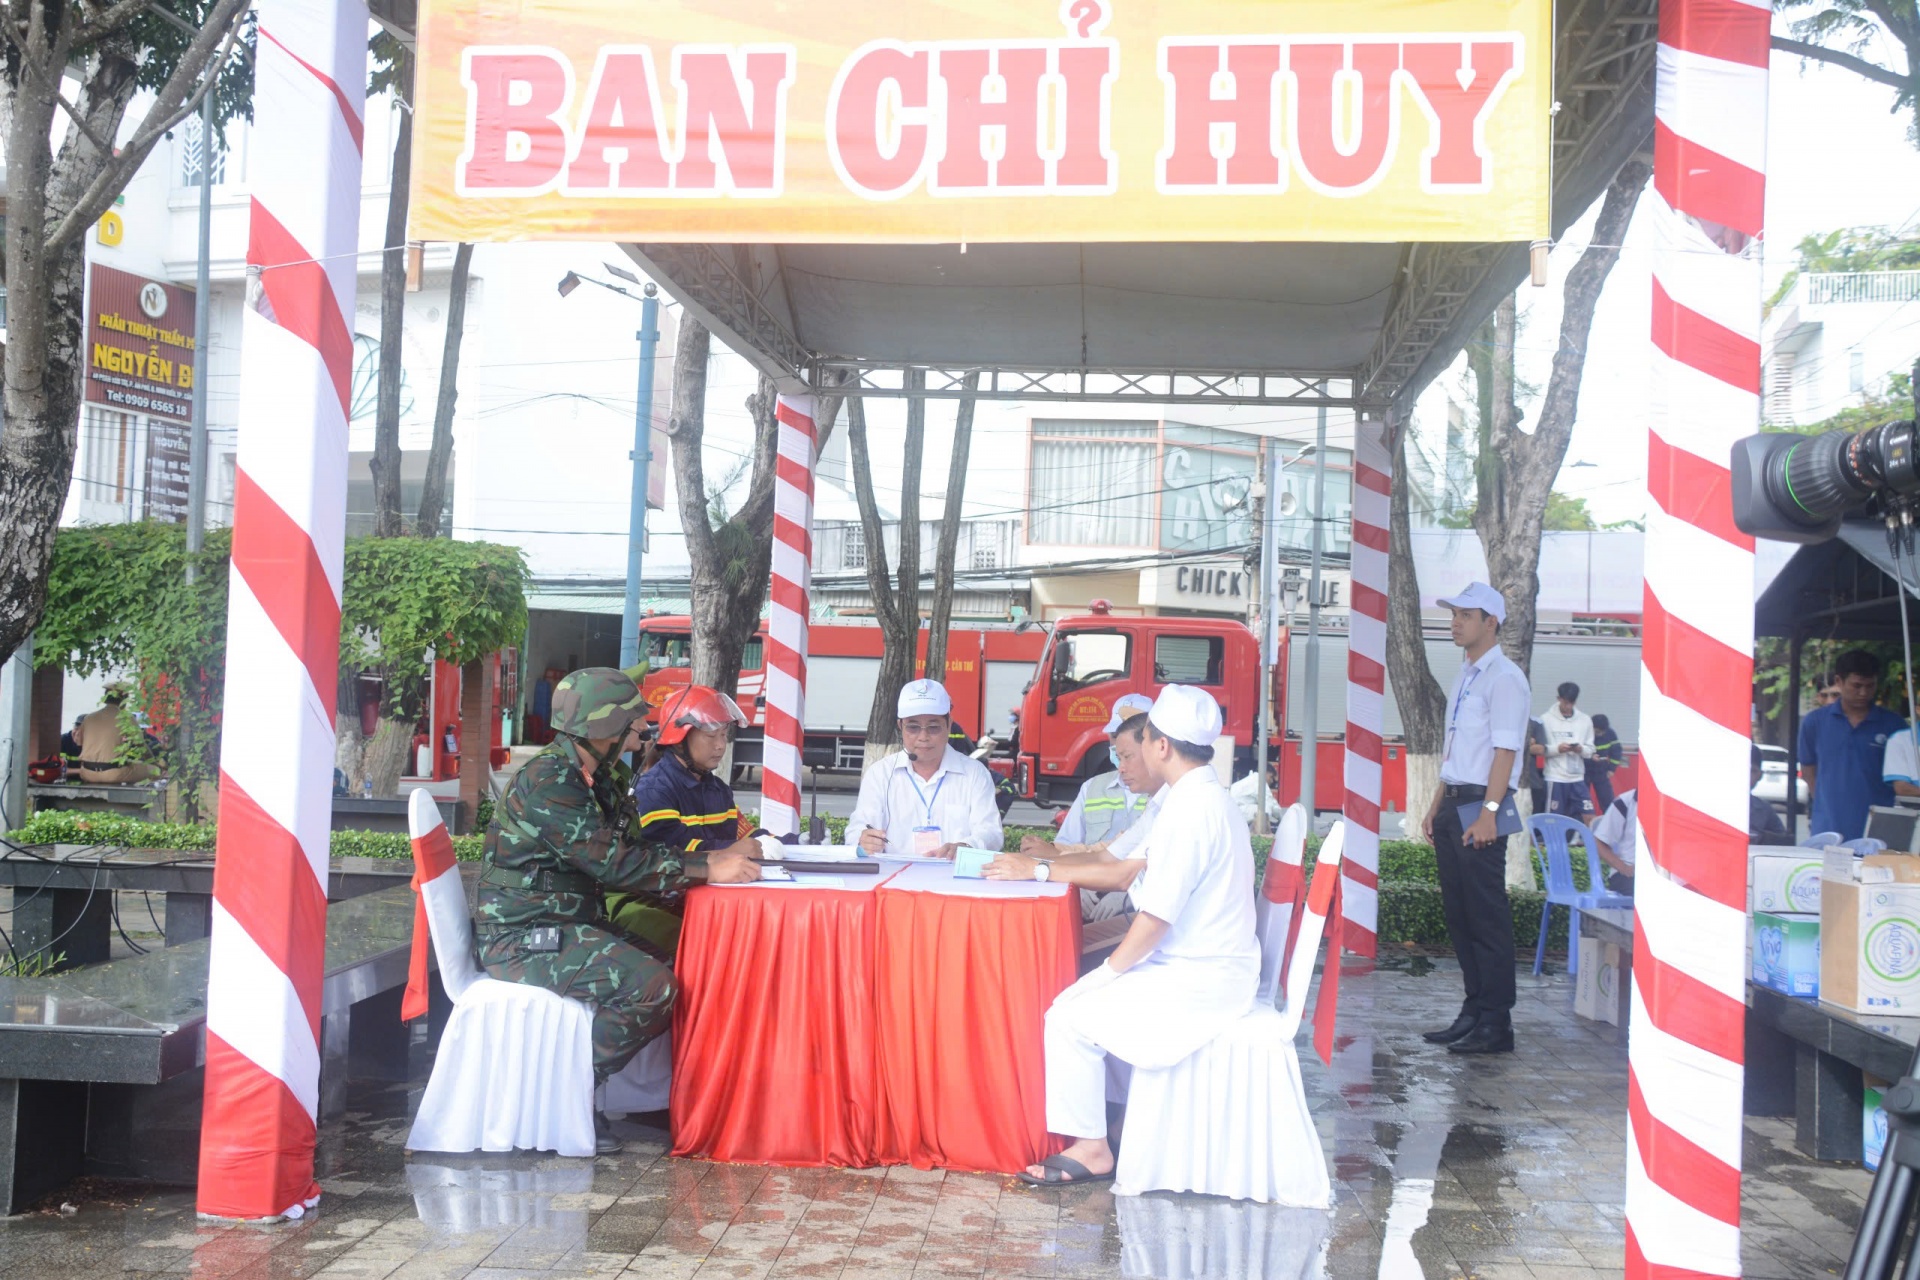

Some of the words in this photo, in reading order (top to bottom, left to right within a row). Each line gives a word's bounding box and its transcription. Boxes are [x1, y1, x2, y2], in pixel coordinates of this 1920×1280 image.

[456, 44, 796, 197] BAN
[826, 0, 1119, 200] CHỈ
[1156, 32, 1525, 198] HUY
[127, 320, 158, 341] THUẬT
[93, 342, 173, 385] NGUYỄN
[106, 389, 125, 403] Tel:
[125, 394, 149, 408] 0909
[150, 400, 174, 414] 6565
[175, 405, 187, 416] 18
[1177, 566, 1243, 597] CHICK
[1791, 885, 1820, 900] AQUAF
[1888, 923, 1902, 976] AQUAFINA
